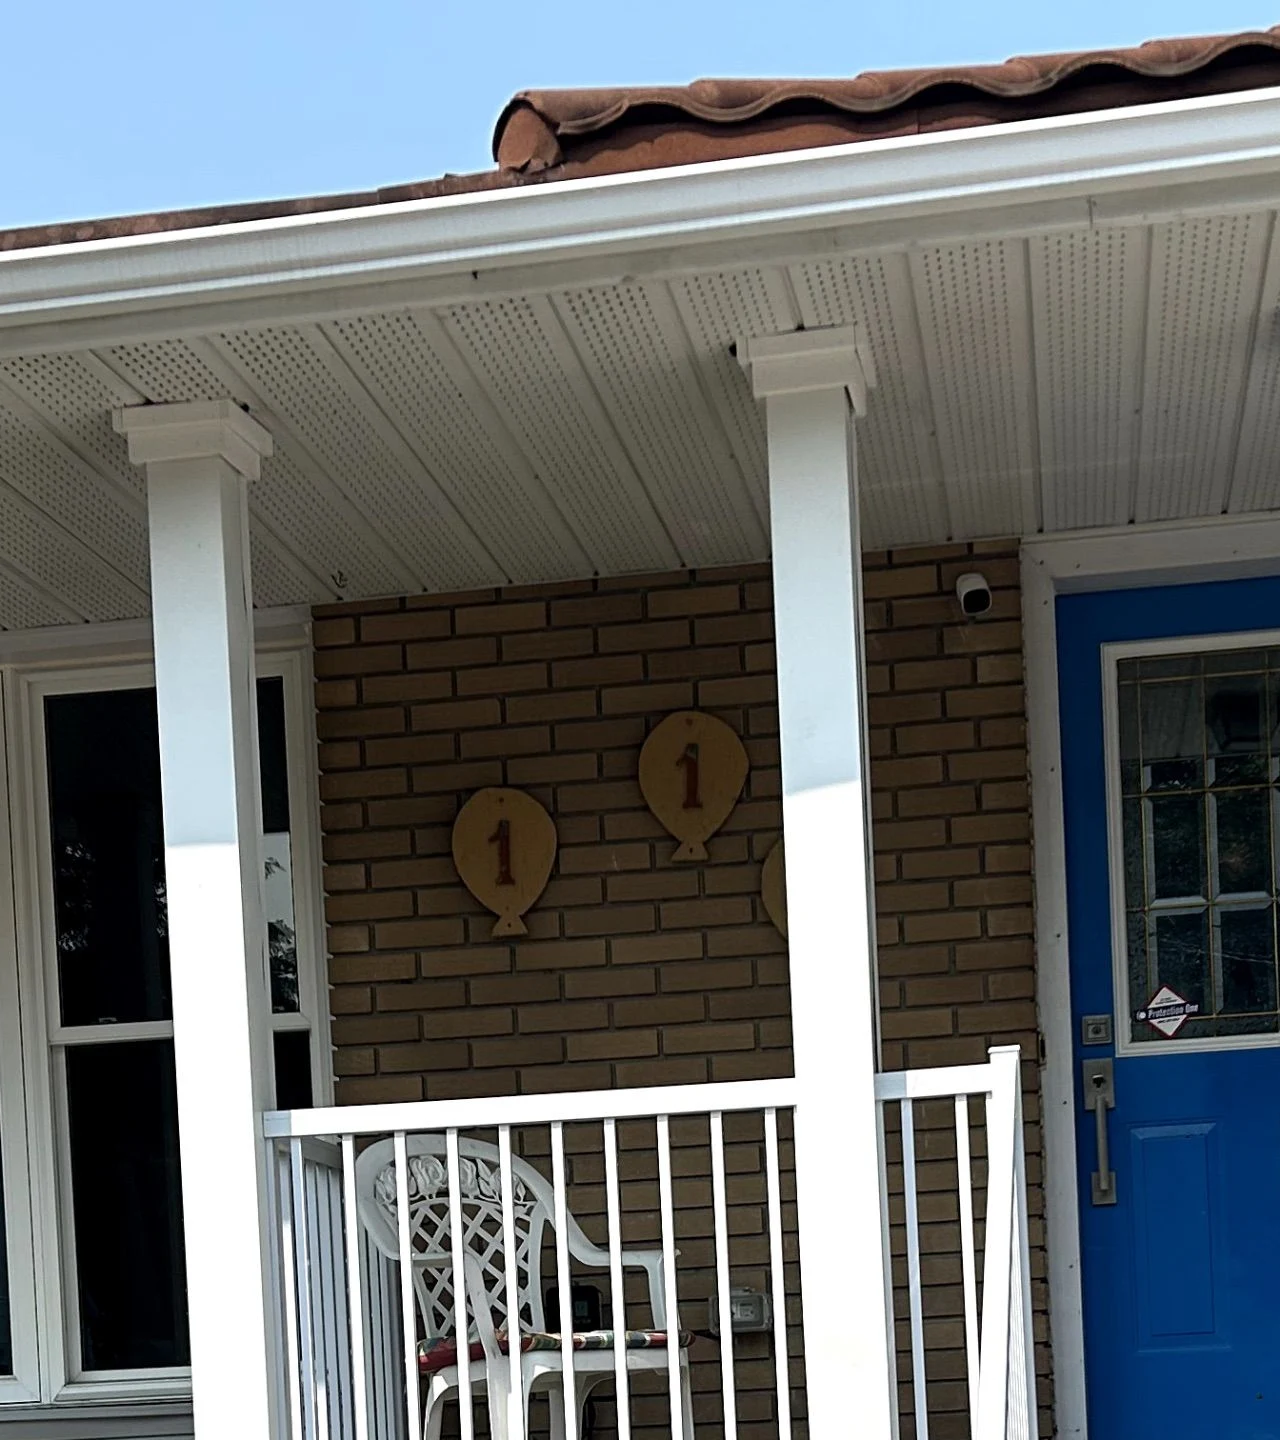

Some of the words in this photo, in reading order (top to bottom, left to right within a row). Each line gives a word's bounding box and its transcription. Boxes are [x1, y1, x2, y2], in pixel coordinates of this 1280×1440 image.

[675, 743, 704, 809] 1
[488, 819, 515, 885] 1
[1148, 1007, 1184, 1018] Protection
